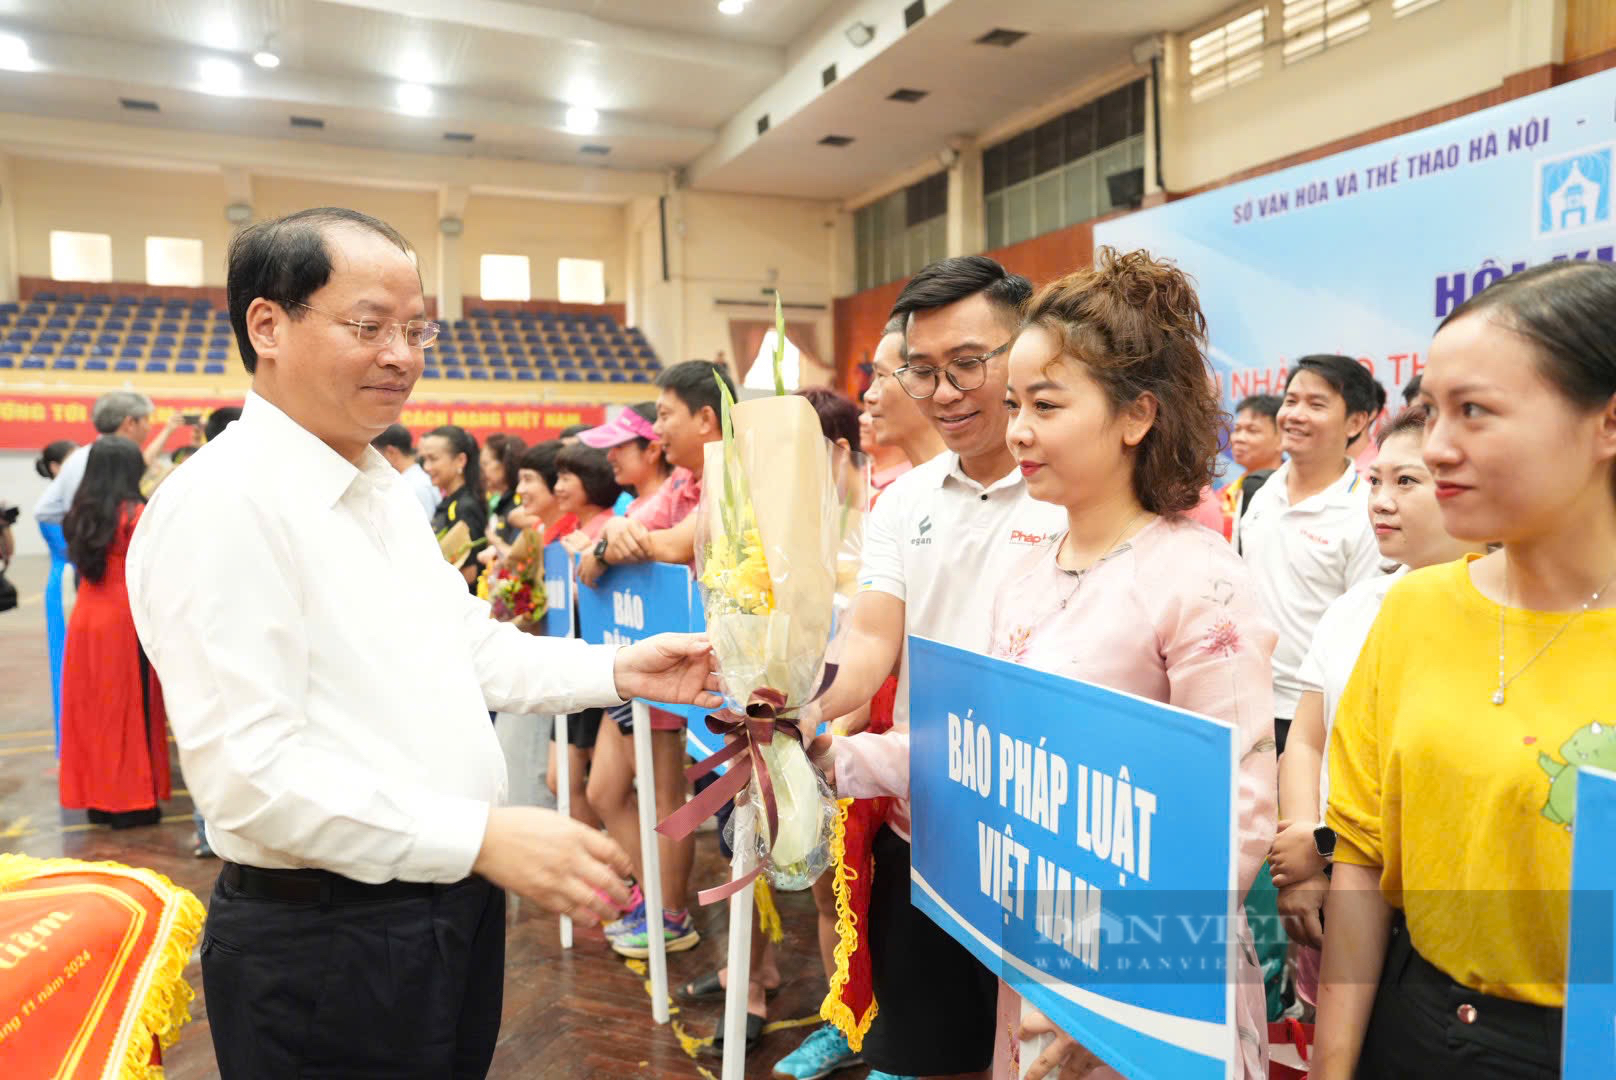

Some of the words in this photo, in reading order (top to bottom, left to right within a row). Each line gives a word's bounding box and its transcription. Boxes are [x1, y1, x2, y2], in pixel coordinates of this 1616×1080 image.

[1408, 144, 1459, 179] THAO
[1508, 117, 1550, 151] NỘI
[948, 709, 992, 799] BÁO
[999, 732, 1068, 835] PHÁP
[1077, 765, 1157, 887] LUẬT
[978, 820, 1029, 926] VIỆT
[1036, 856, 1102, 972] NAM
[64, 948, 91, 979] 2024
